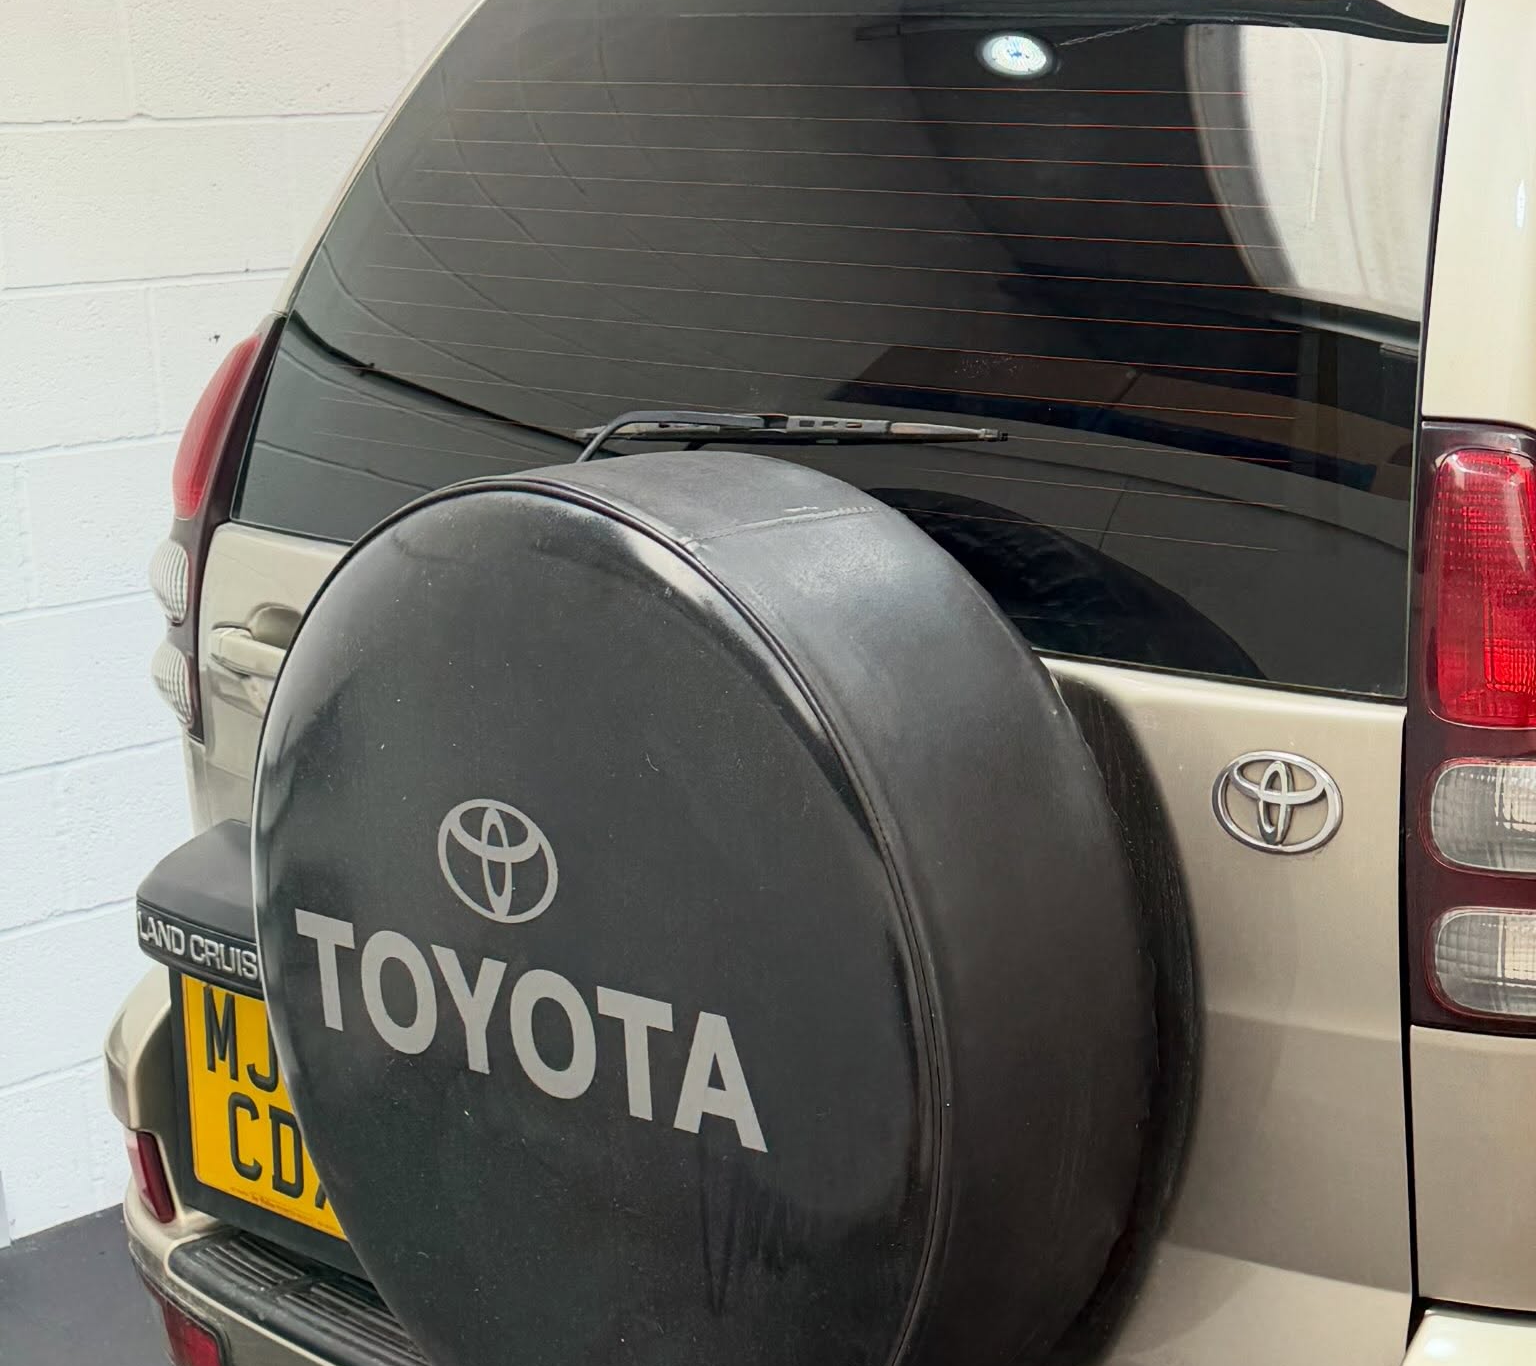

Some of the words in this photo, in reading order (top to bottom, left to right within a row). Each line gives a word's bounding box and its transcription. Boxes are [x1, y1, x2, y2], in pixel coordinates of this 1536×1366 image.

[137, 910, 185, 956] LAND
[294, 907, 769, 1154] TOYOTA
[227, 1091, 327, 1210] CD
